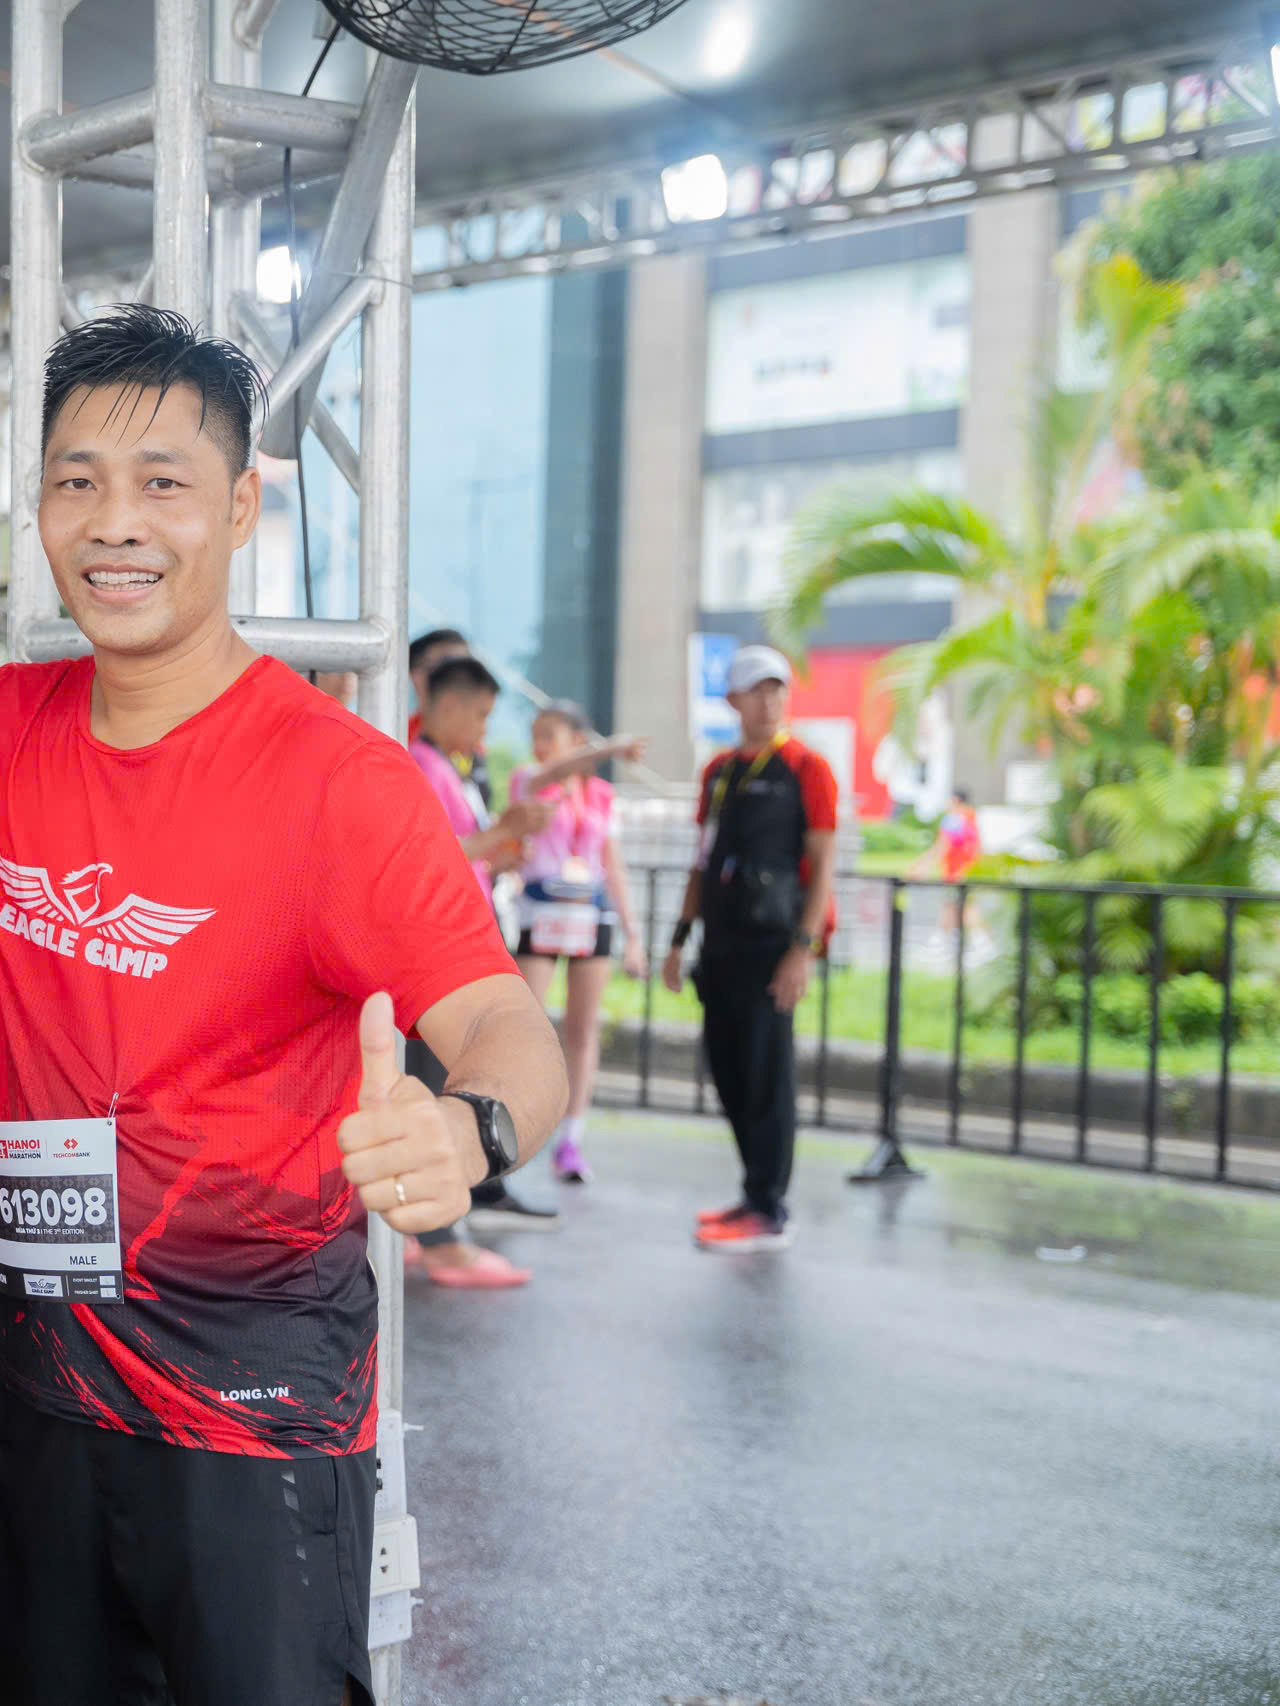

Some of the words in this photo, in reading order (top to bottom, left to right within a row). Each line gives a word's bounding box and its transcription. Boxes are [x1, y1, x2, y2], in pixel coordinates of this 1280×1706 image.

[84, 938, 168, 978] CAMP
[8, 1140, 40, 1149] HANOI
[0, 1187, 107, 1226] 613098
[70, 1256, 97, 1265] MALE
[220, 1387, 289, 1401] LONG.VN
